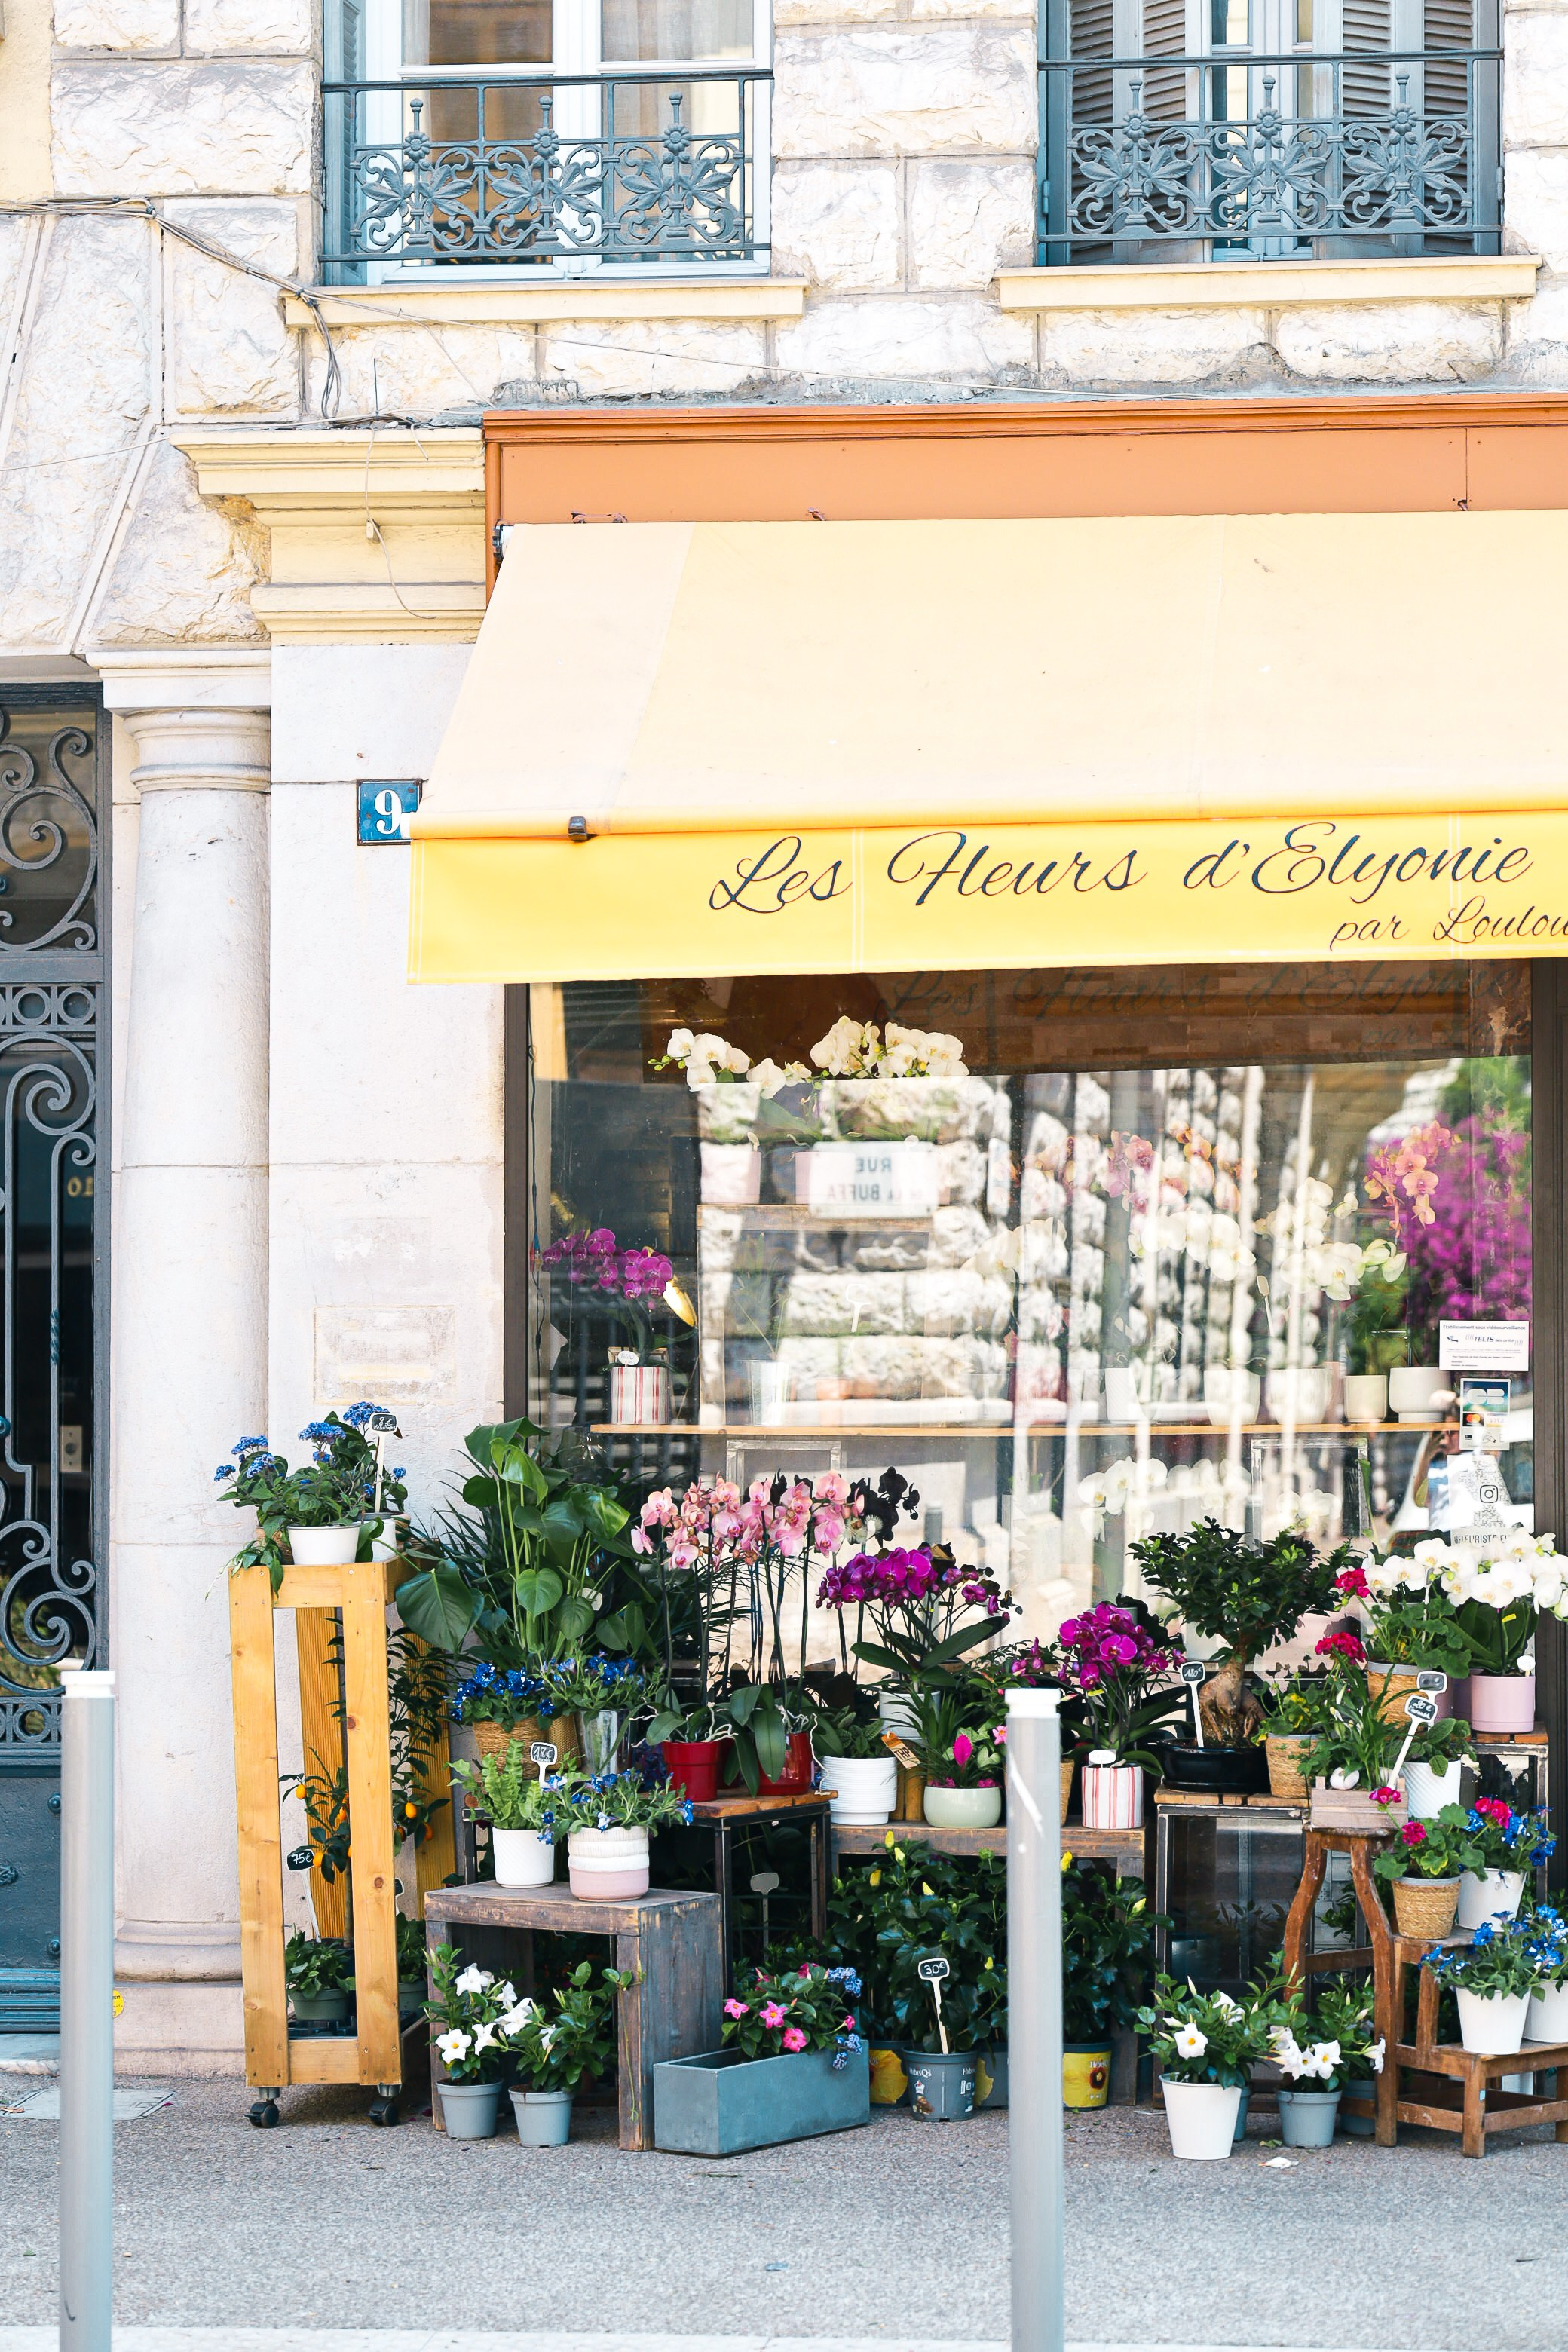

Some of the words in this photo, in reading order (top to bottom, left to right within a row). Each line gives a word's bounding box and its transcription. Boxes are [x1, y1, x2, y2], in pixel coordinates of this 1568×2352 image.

[375, 789, 403, 835] 9
[709, 835, 853, 914] Les
[887, 831, 1148, 906] Fleurs
[1183, 822, 1535, 904] d'Elyonie
[1330, 914, 1410, 951] par
[893, 1747, 911, 1761] THP
[291, 1852, 313, 1864] 75€
[924, 1962, 946, 1975] 30€
